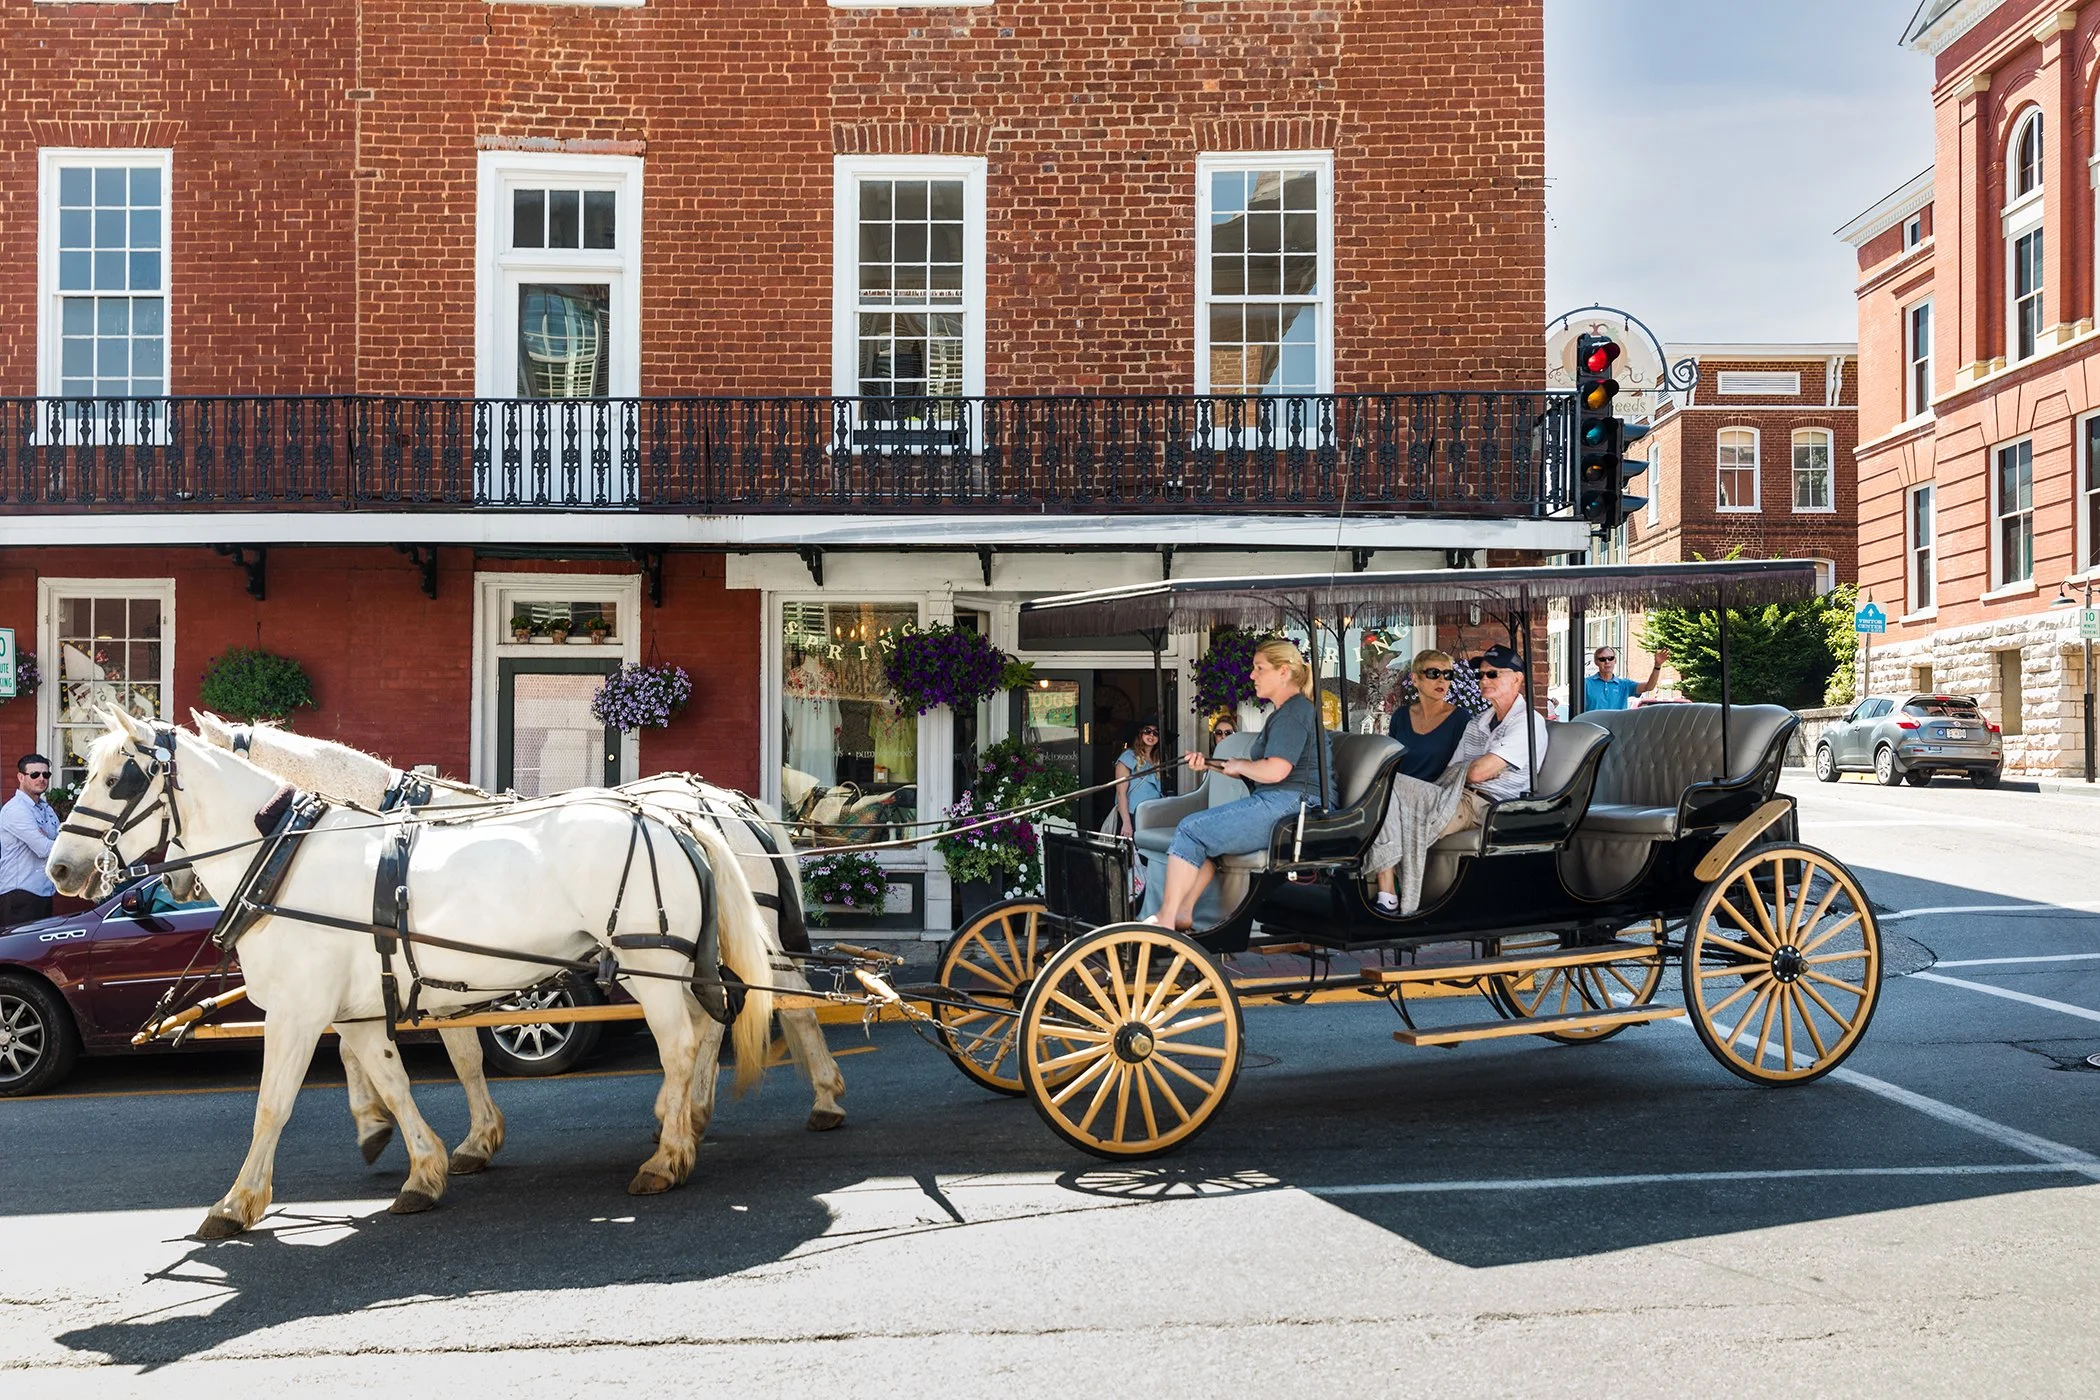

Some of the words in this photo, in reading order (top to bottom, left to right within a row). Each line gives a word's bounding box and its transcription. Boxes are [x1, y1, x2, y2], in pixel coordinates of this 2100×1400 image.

[1614, 398, 1647, 413] eeds
[2085, 612, 2095, 621] 10
[783, 620, 917, 661] SPRING
[1031, 693, 1076, 708] DOGS
